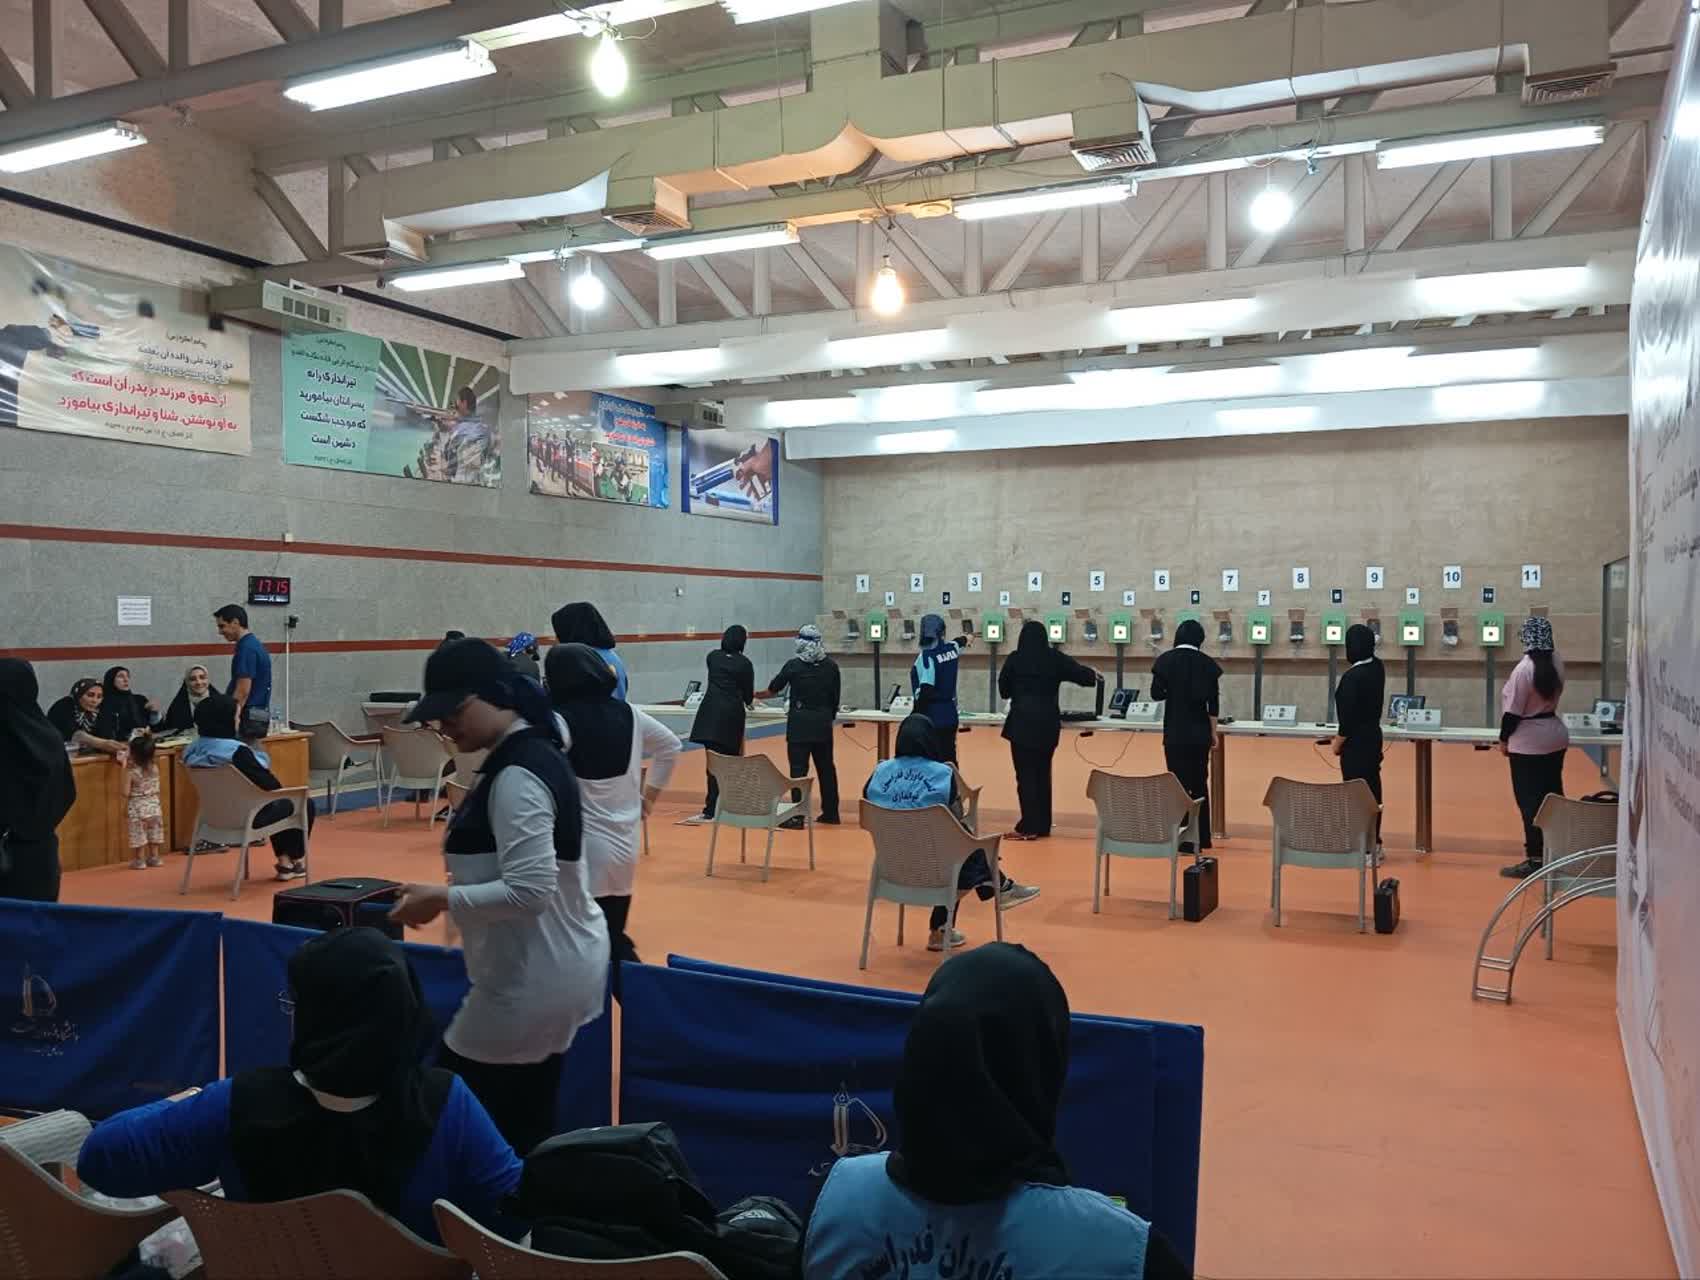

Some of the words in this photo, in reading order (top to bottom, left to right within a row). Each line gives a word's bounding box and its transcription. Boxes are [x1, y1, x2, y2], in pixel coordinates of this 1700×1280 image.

[101, 400, 152, 420] تیراندازی
[1445, 571, 1461, 583] 10
[1524, 570, 1538, 582] 11
